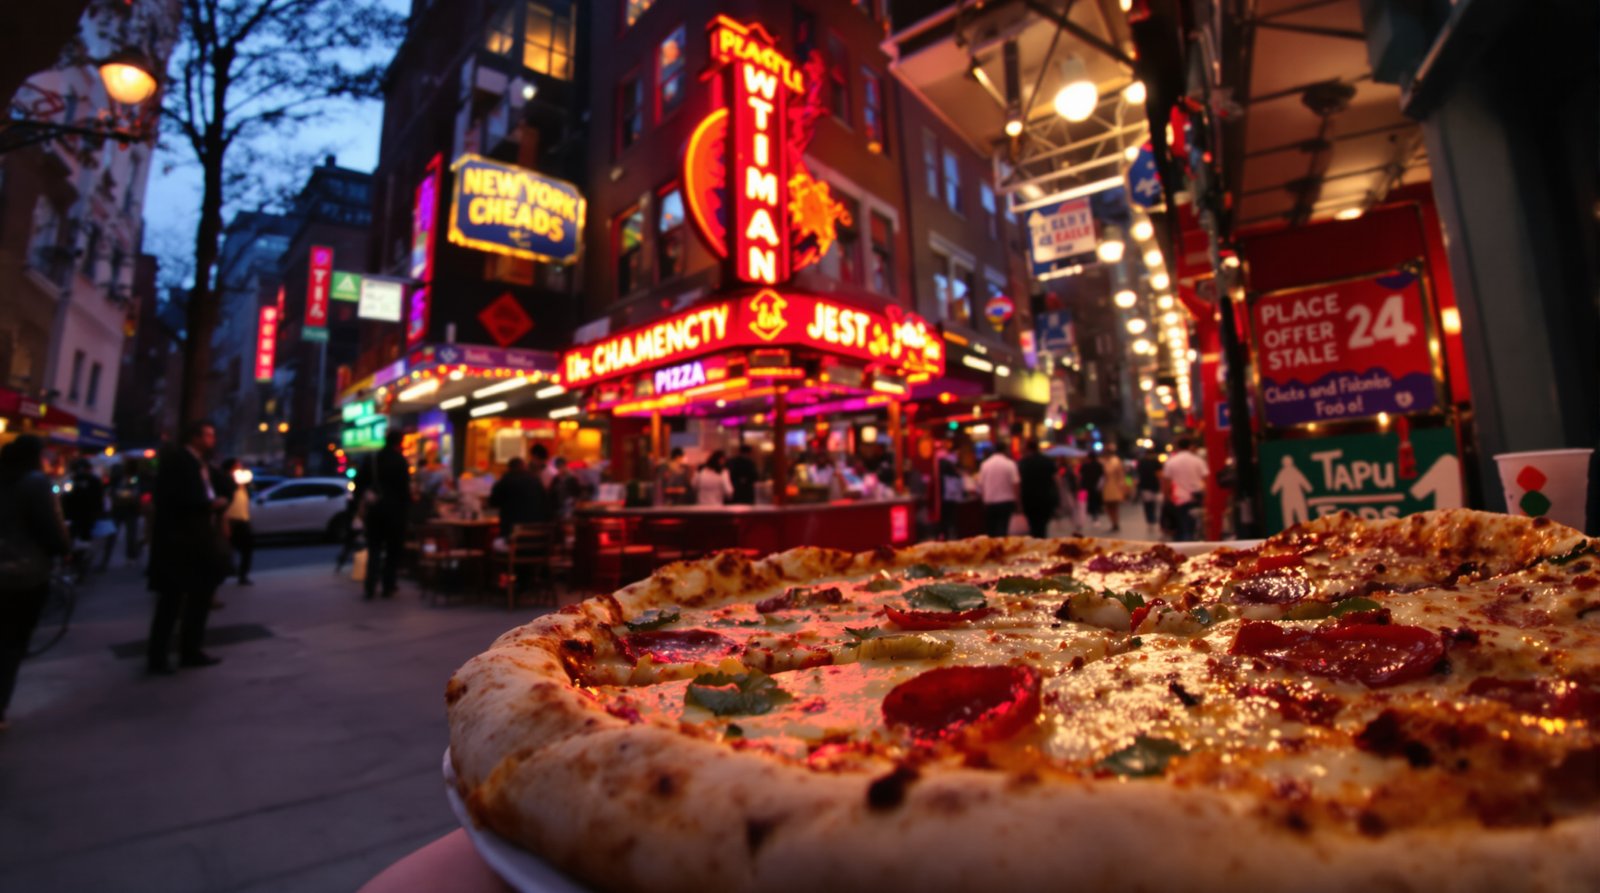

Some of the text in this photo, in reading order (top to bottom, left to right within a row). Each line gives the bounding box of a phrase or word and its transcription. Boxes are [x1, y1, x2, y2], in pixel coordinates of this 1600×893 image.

[743, 62, 780, 284] WTIMAN
[464, 168, 577, 222] NEW YORK
[806, 302, 870, 348] JEST
[1260, 293, 1341, 325] PLACE
[1346, 295, 1417, 349] 24
[592, 304, 729, 376] CHAMENCTY
[1263, 321, 1335, 349] OFFER
[1267, 343, 1340, 370] STALE
[654, 360, 705, 394] PIZZA
[1309, 379, 1336, 398] and
